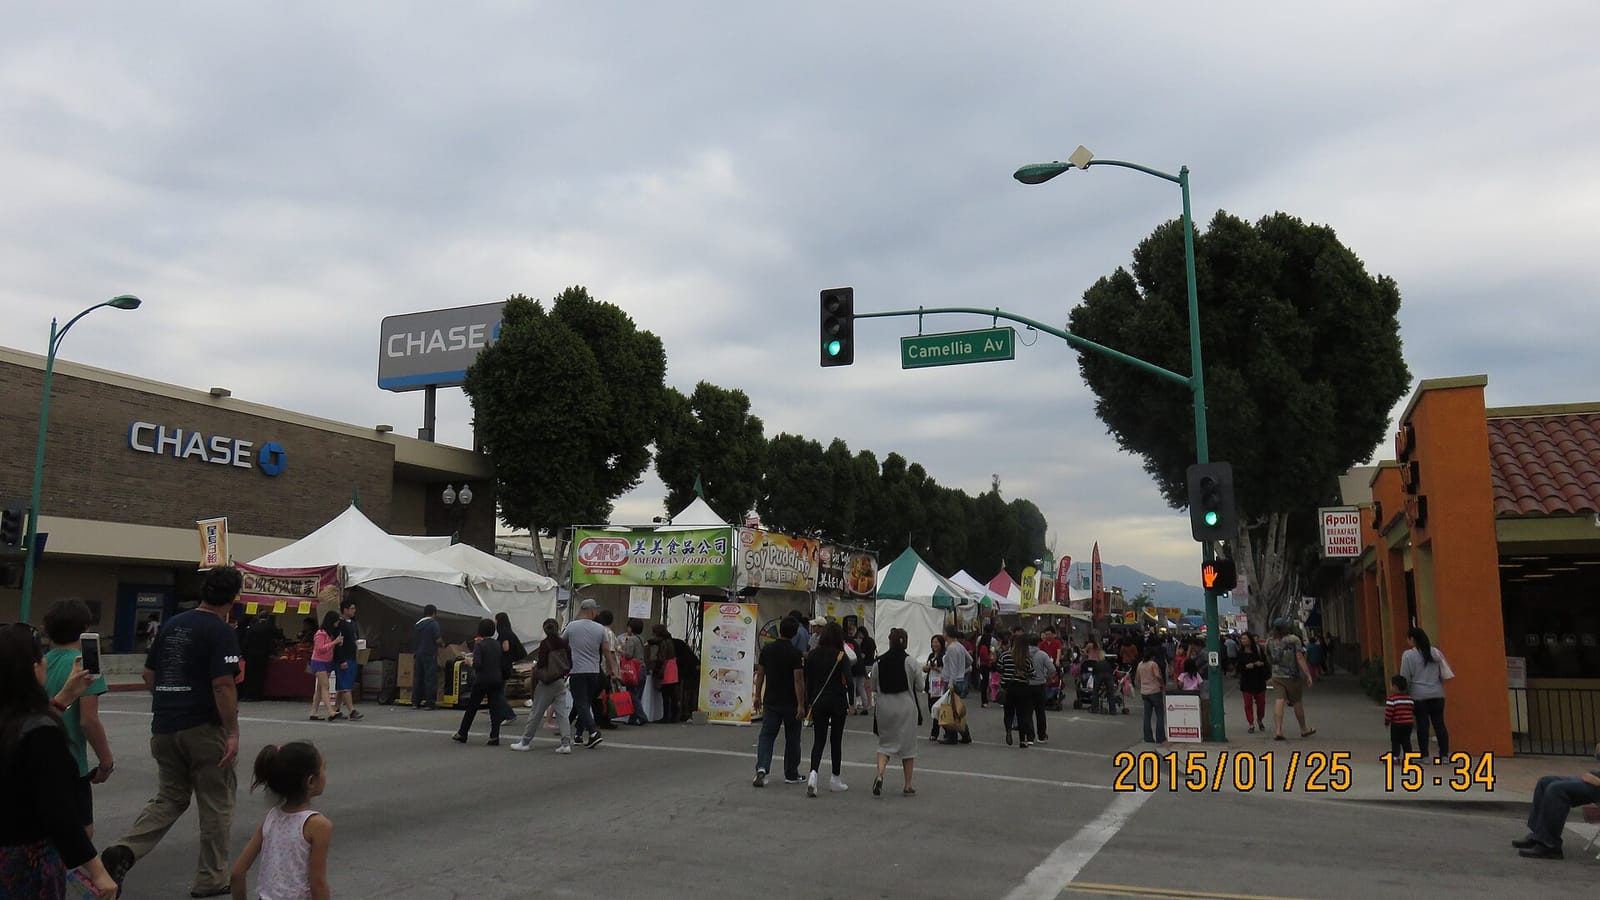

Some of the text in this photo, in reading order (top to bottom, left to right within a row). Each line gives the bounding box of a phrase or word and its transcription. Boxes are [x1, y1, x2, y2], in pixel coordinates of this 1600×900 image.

[387, 323, 487, 358] CHASE
[908, 338, 1004, 359] Camellia Av
[129, 420, 254, 469] CHASE
[1325, 514, 1359, 527] Apollo
[1326, 528, 1358, 536] BREAKFAST
[1329, 537, 1357, 545] LUNCH
[584, 543, 620, 562] AFC
[632, 536, 728, 556] 美美食品公司
[1327, 546, 1359, 555] DINNER
[633, 556, 724, 566] AMERICAN FOOD CO.
[745, 548, 767, 571] Soy
[769, 544, 811, 579] Pudding
